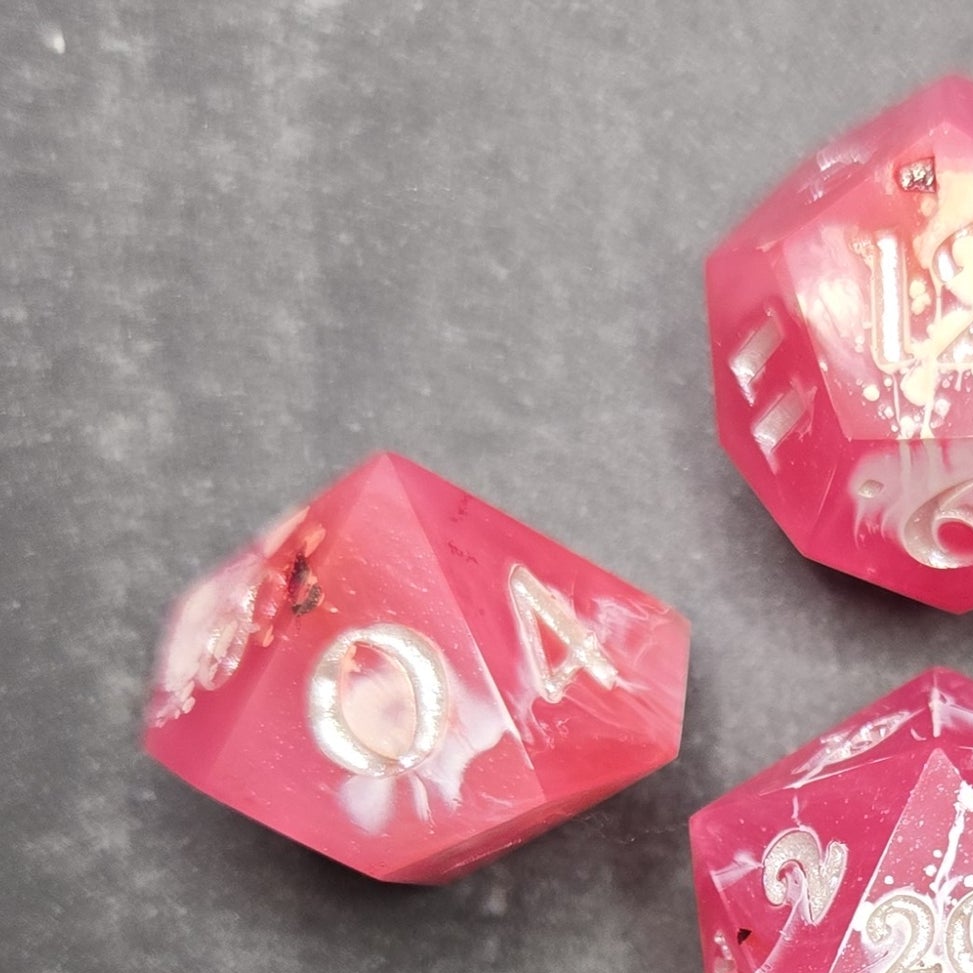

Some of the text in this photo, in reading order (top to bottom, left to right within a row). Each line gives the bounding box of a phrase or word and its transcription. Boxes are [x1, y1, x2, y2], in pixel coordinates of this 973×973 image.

[310, 623, 450, 780] 0
[509, 563, 622, 703] 4
[761, 826, 848, 925] 2
